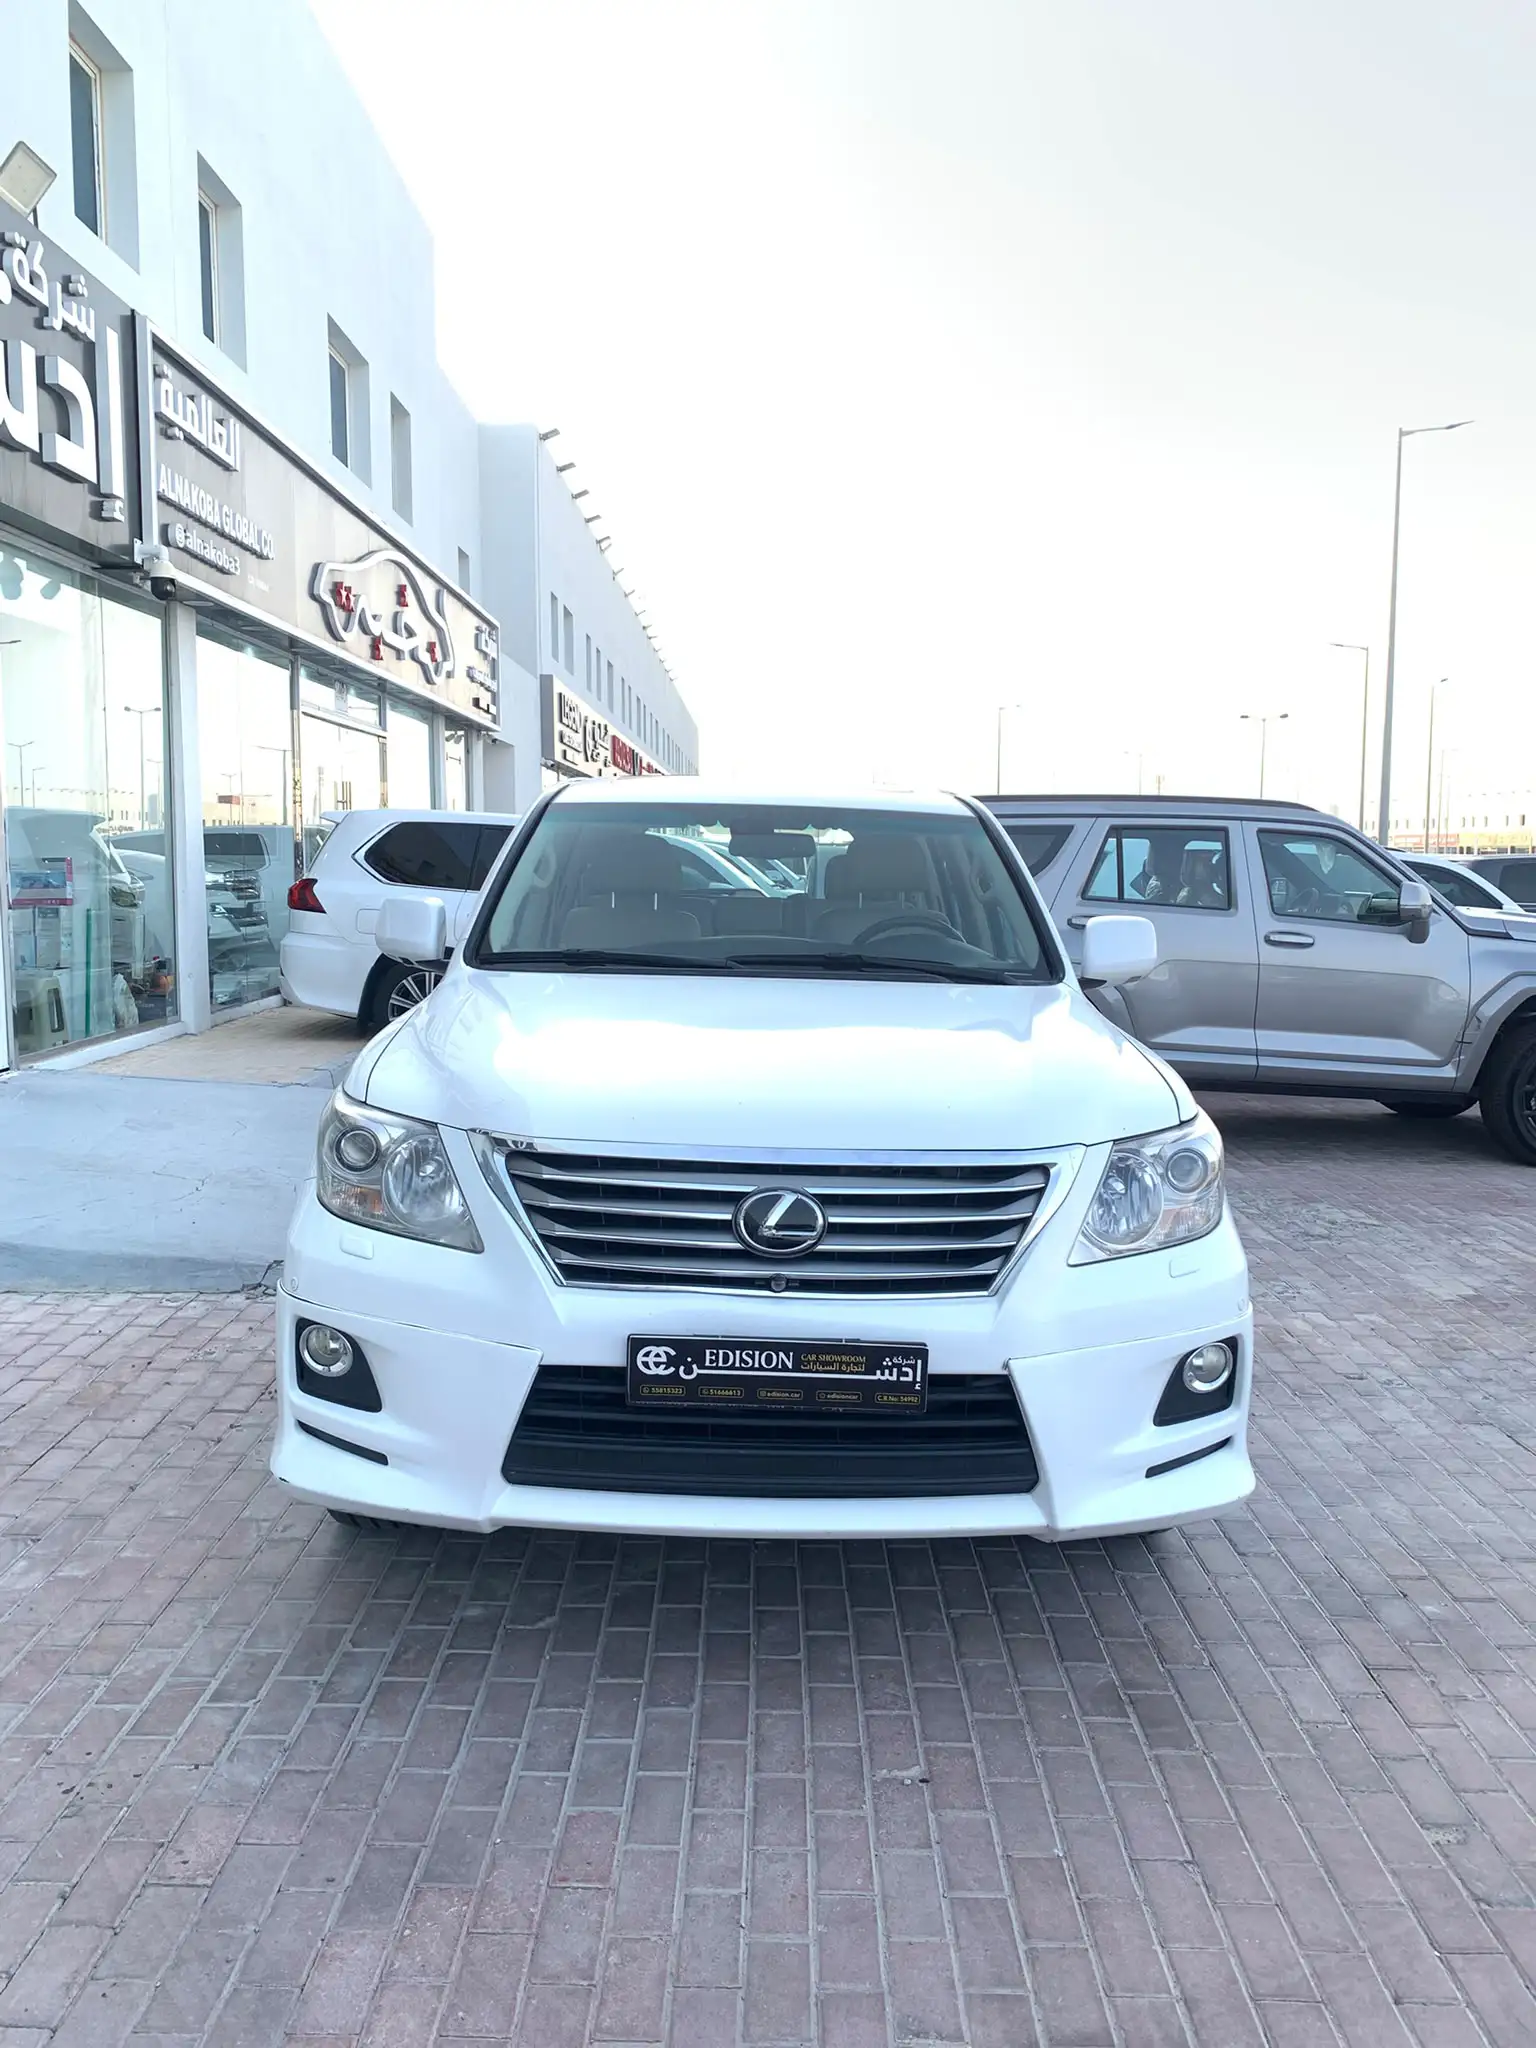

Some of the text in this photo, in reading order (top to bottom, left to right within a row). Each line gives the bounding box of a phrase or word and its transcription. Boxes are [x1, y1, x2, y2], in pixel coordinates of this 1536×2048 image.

[3, 231, 95, 342] شركة
[154, 363, 240, 472] العالمية
[158, 463, 221, 528] ALNAKOBA
[222, 504, 261, 552] GLOBAL
[704, 1349, 794, 1369] EDISION
[800, 1353, 866, 1363] CAR SHOWROOM
[800, 1362, 865, 1372] لتجارة السيارات
[892, 1355, 916, 1364] شركة
